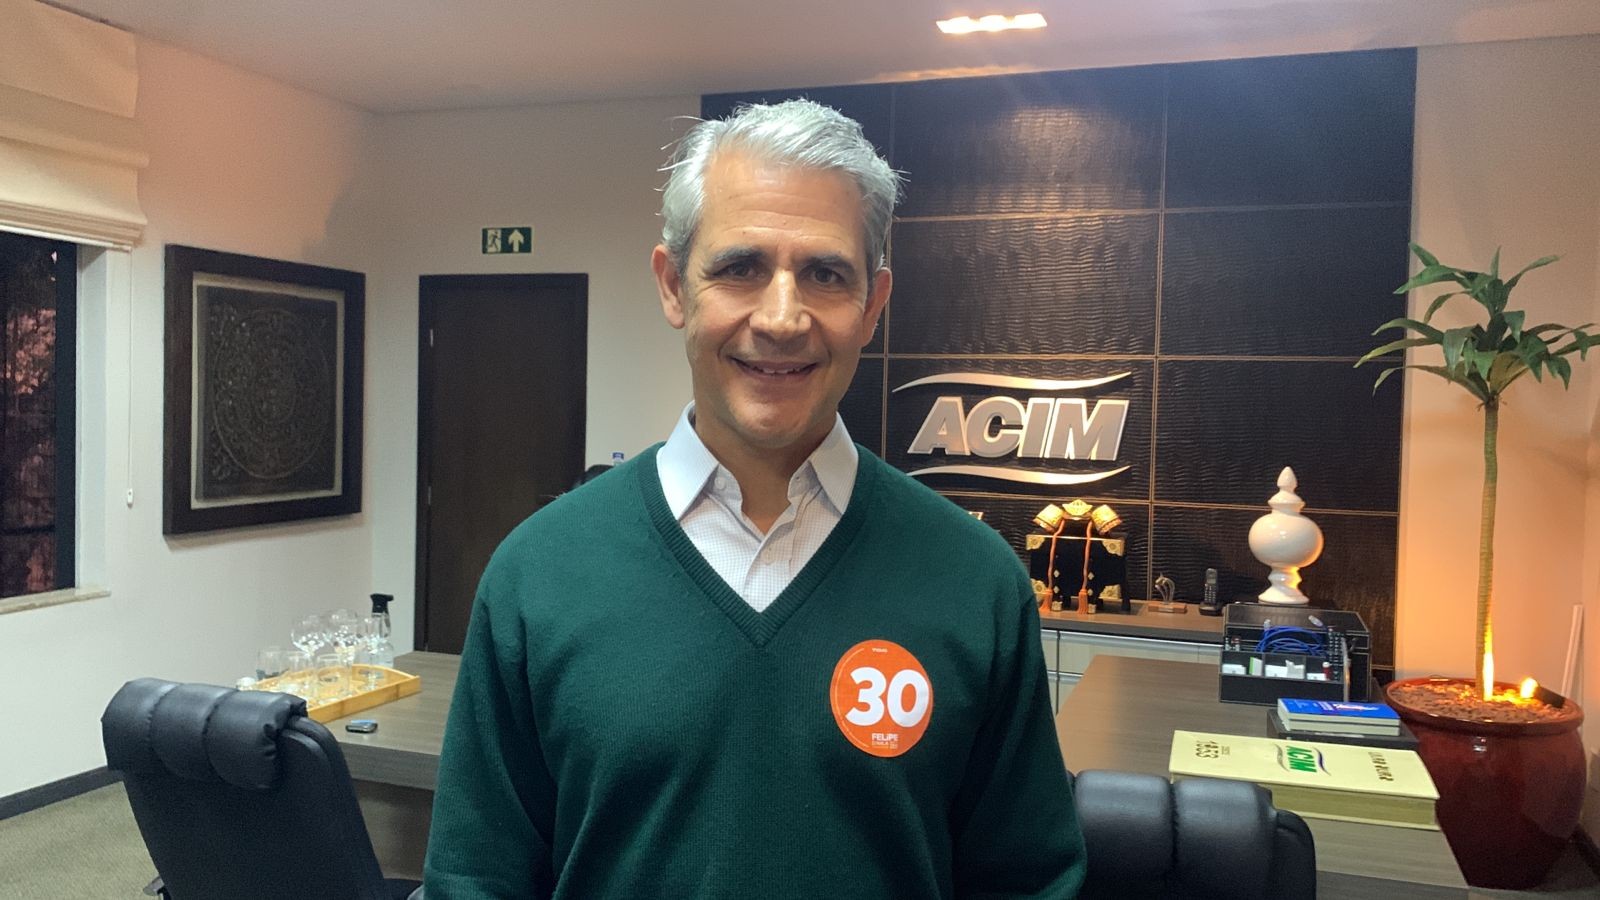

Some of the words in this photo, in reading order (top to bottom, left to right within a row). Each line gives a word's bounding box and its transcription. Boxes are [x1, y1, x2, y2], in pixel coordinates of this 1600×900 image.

[907, 396, 1130, 461] ACIM
[845, 667, 930, 727] 30
[871, 733, 898, 742] FELIPE
[1285, 745, 1317, 773] ACIM
